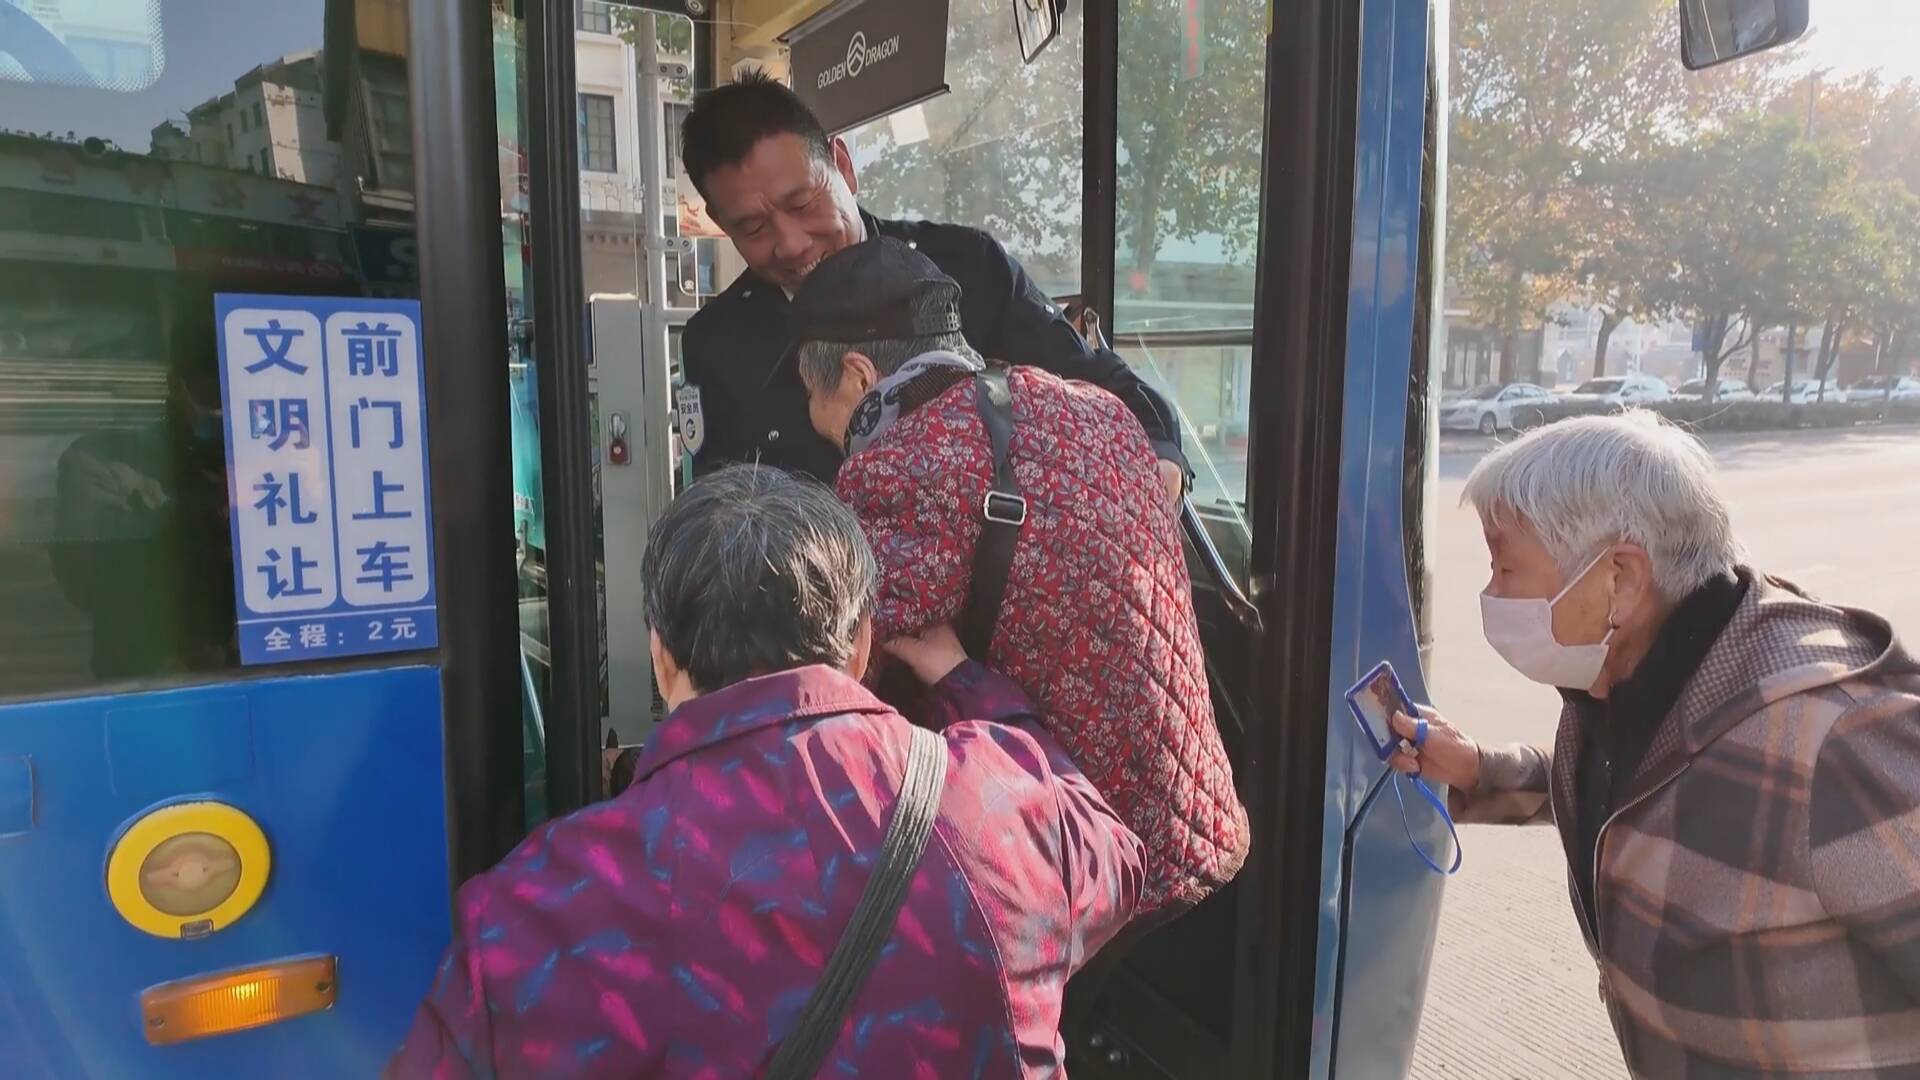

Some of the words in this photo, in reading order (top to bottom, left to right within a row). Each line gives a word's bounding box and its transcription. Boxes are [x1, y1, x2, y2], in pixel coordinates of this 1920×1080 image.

[817, 61, 847, 89] GOLDEN
[865, 34, 900, 67] DRAGON
[243, 319, 323, 600] 文明礼让
[341, 322, 414, 593] 前门上车
